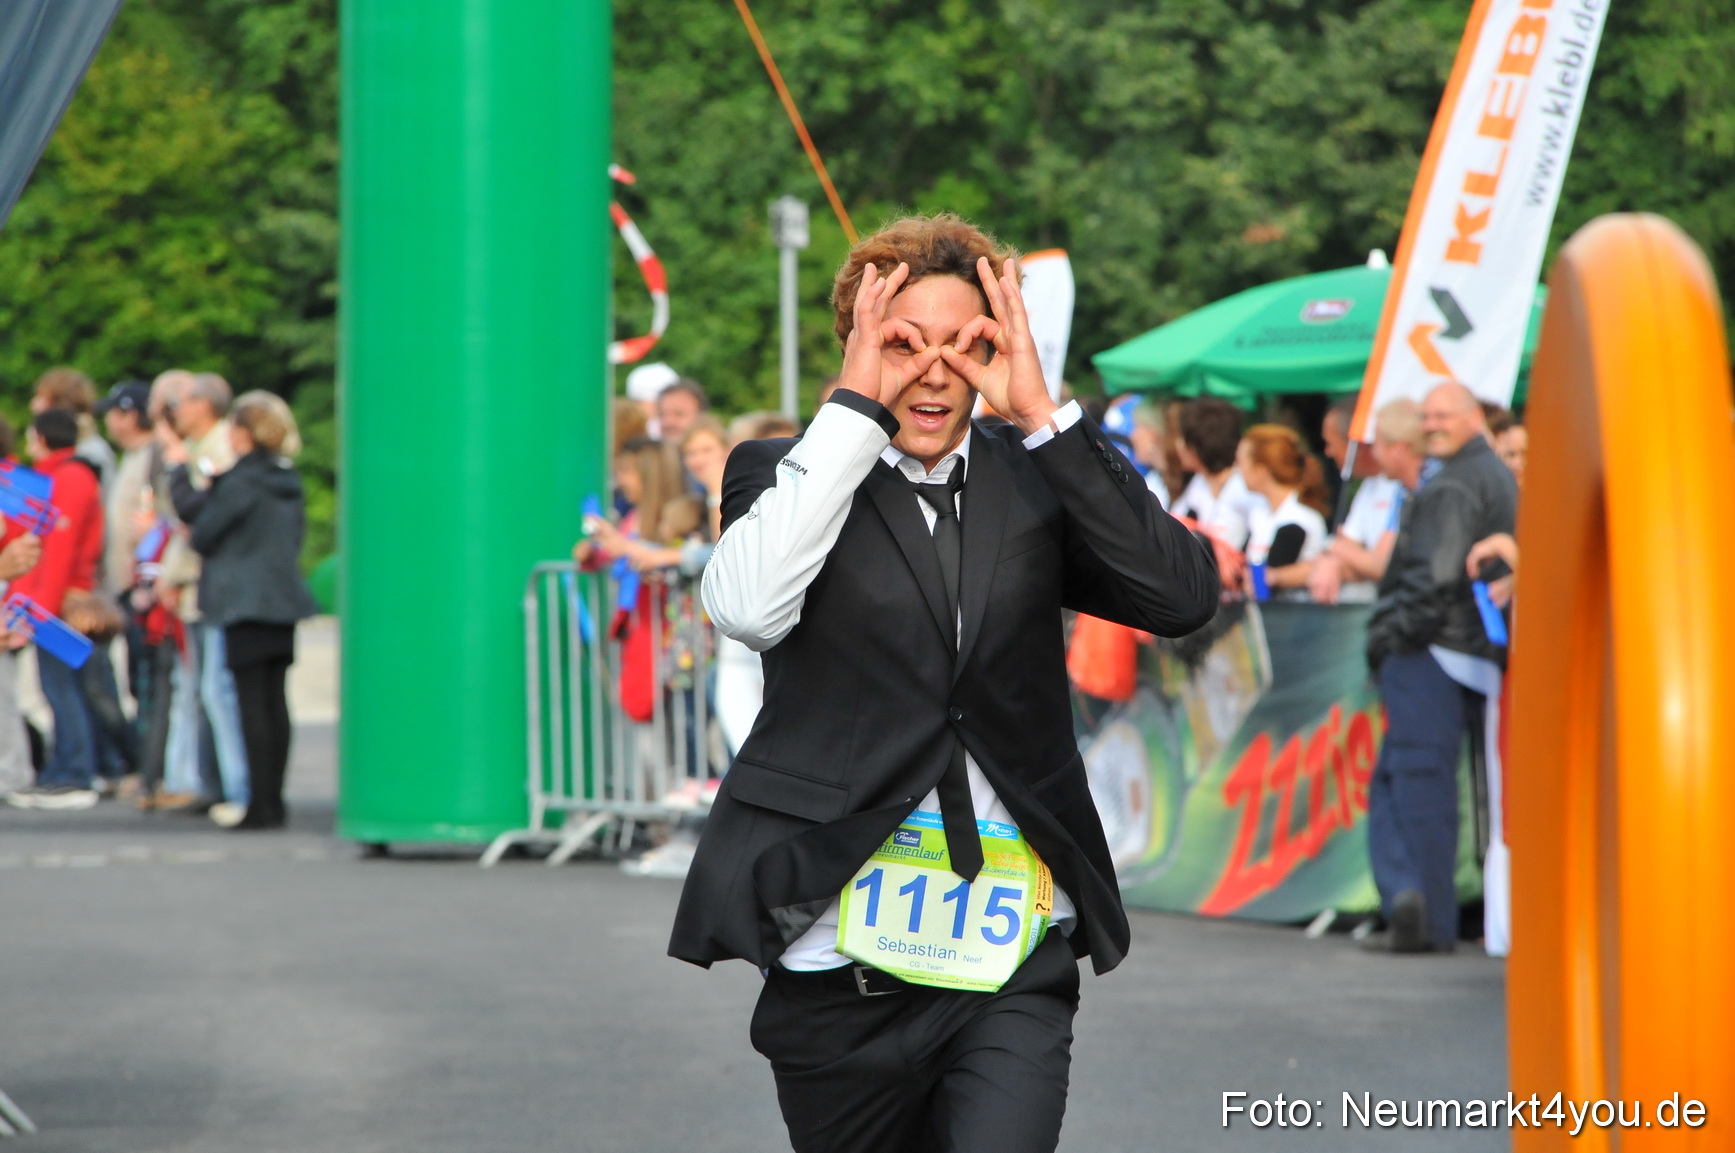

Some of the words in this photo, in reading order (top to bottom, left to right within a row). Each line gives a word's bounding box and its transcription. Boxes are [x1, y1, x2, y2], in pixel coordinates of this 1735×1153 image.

[1444, 0, 1555, 265] KLEB
[855, 867, 1023, 946] 1115
[877, 936, 957, 961] Sebastian
[962, 953, 984, 964] Neef
[909, 960, 921, 968] CG
[926, 962, 945, 971] Team
